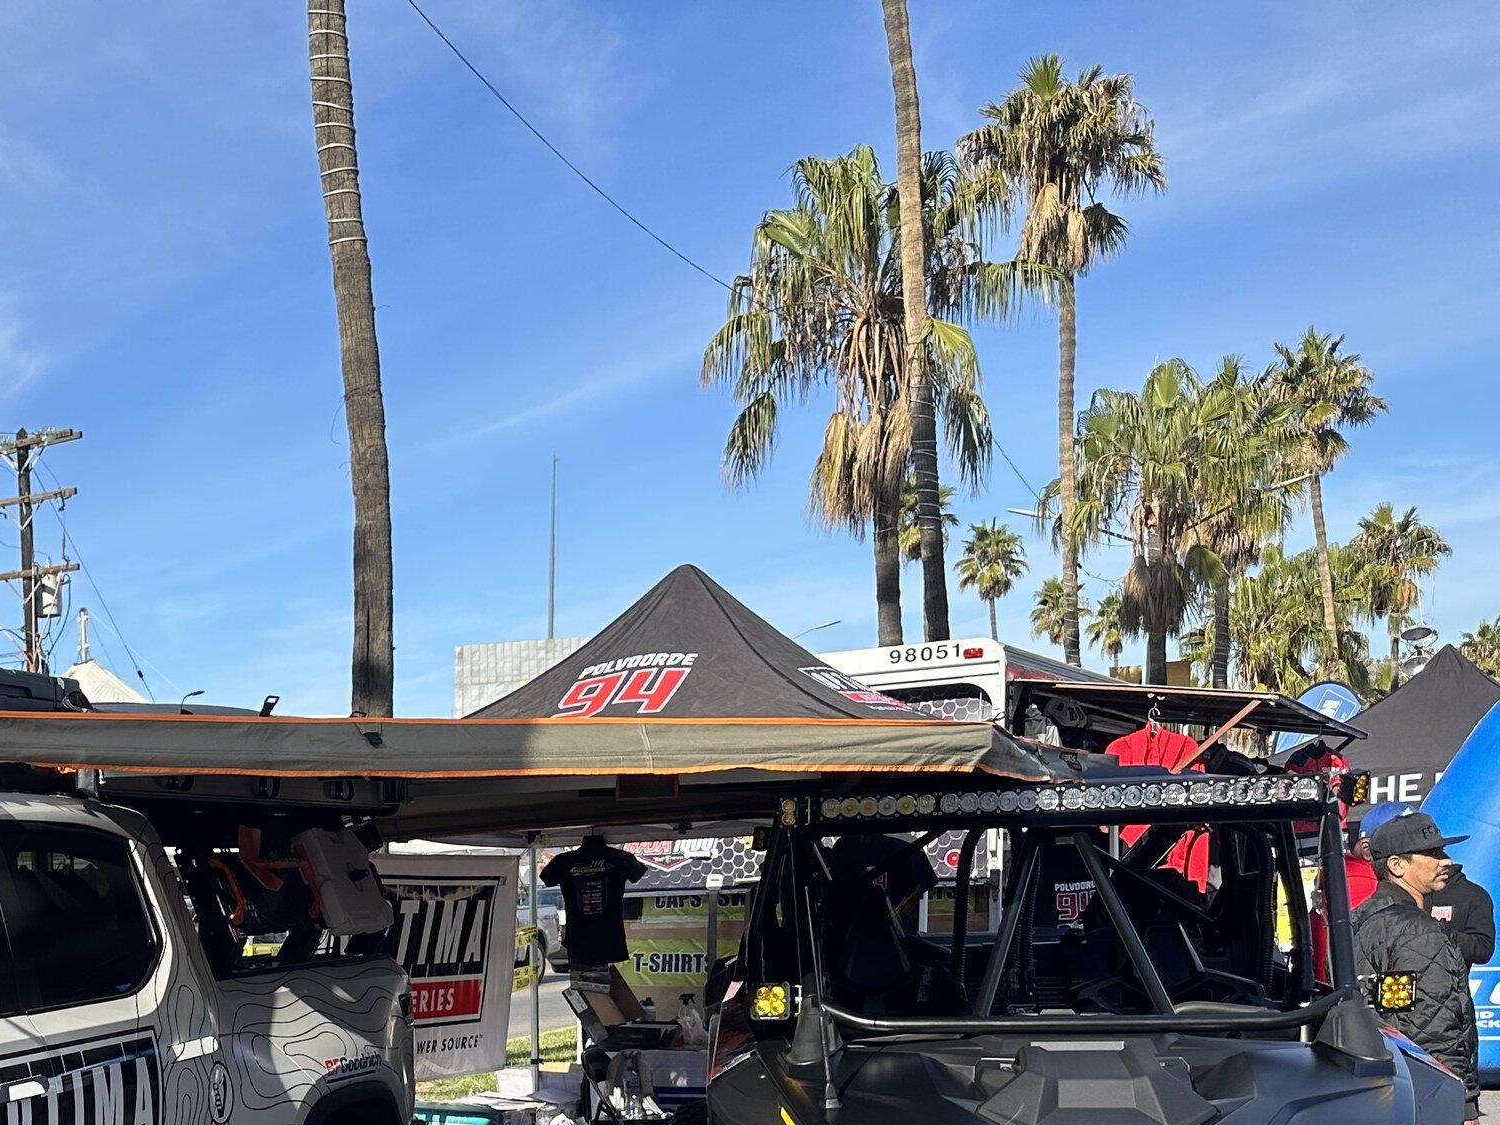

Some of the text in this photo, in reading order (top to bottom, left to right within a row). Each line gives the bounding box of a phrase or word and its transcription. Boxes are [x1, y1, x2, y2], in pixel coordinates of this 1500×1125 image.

[578, 652, 699, 680] POLVOORDE
[889, 643, 960, 664] 98051
[550, 667, 692, 718] 94
[396, 900, 486, 966] TIMA
[441, 1034, 479, 1052] SOURCE
[324, 1050, 382, 1077] BFGoodrich
